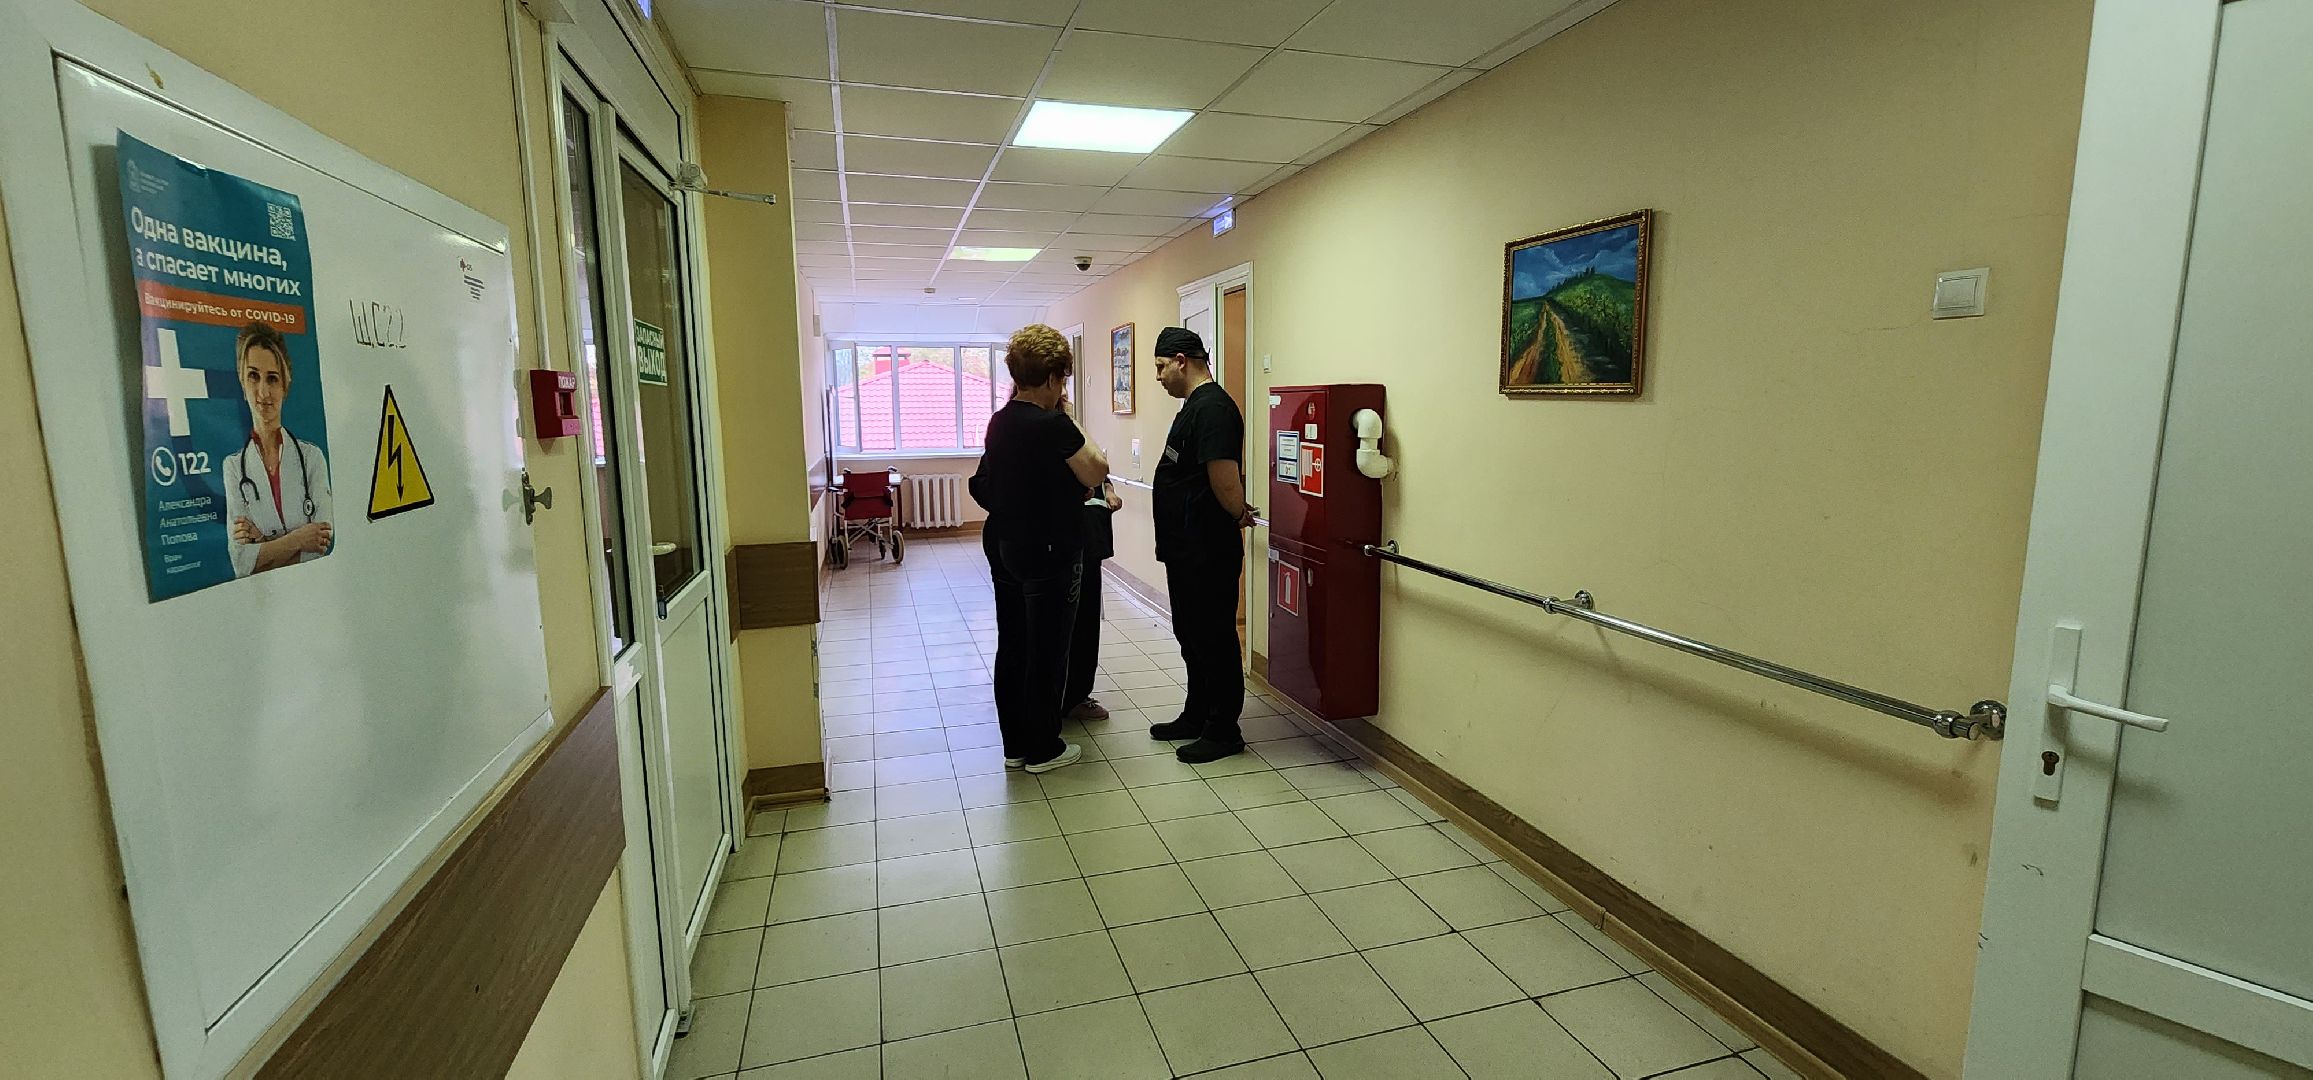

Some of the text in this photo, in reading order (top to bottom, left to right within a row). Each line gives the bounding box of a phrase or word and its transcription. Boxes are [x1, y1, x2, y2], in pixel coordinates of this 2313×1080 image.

[131, 206, 287, 272] Одна вакцина,
[135, 248, 301, 297] а спасает многих
[144, 292, 295, 324] Вакцинируйтесь от COVID-19
[638, 345, 667, 382] ВЫХОД
[558, 375, 575, 389] ПОЖАР
[178, 451, 212, 476] 122
[159, 496, 212, 511] Александра
[161, 532, 198, 546] Попова
